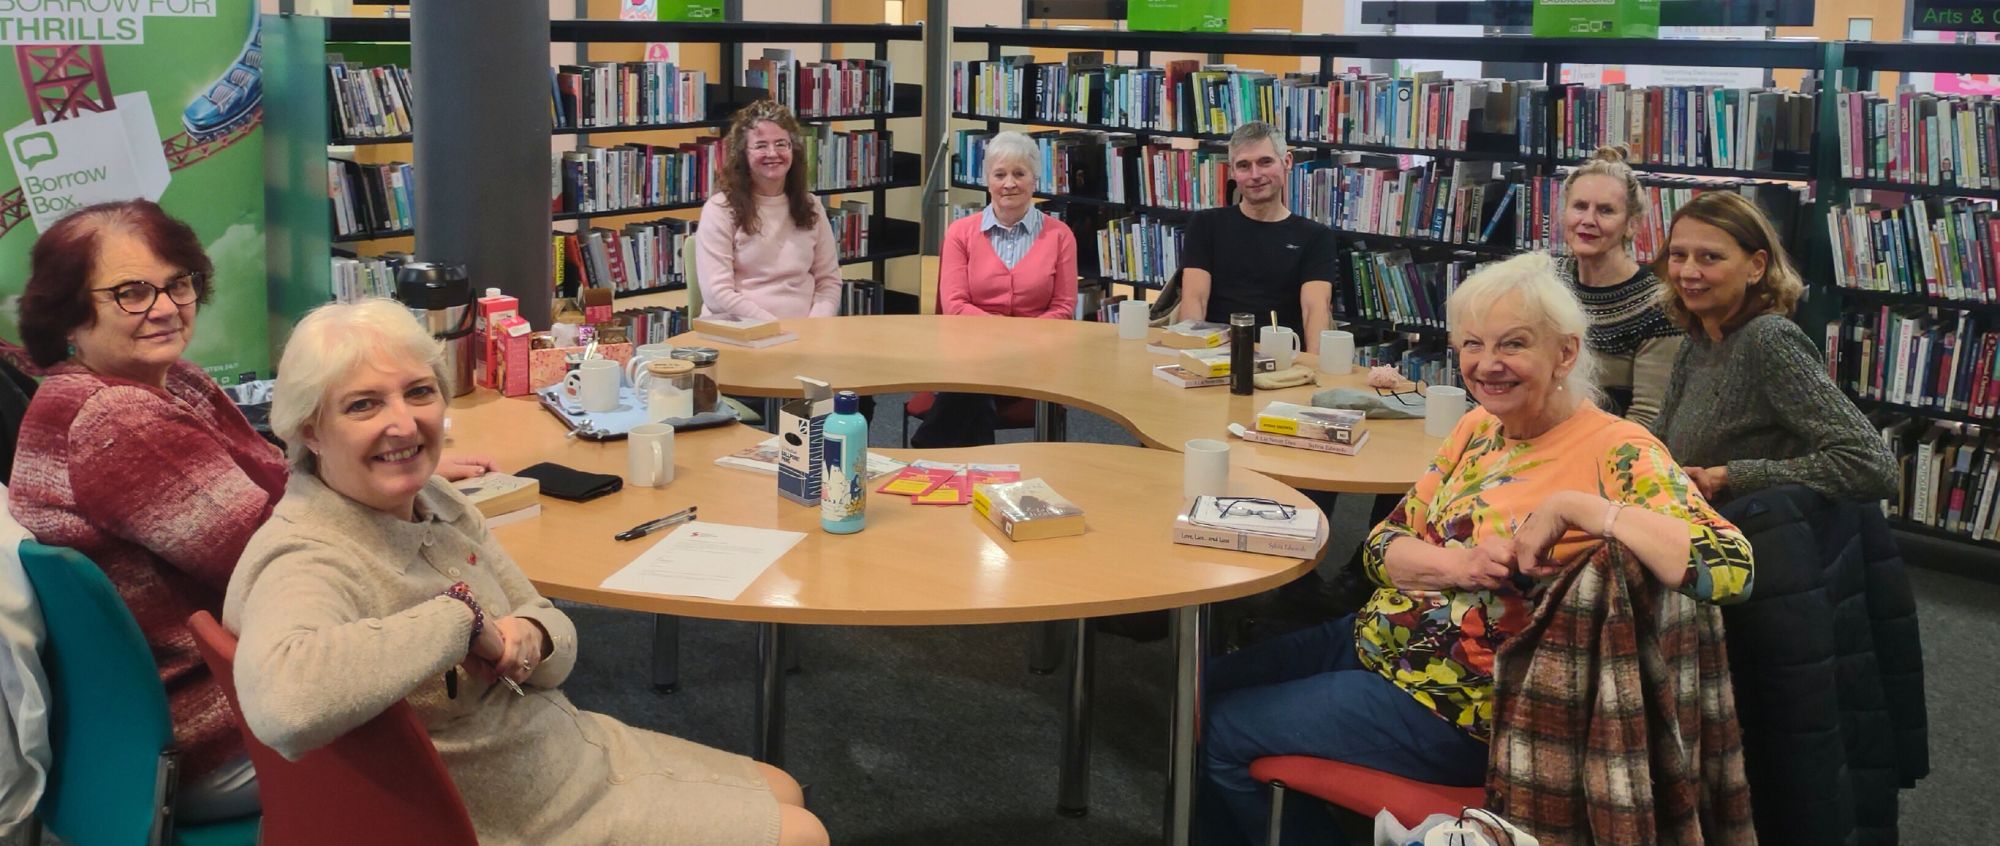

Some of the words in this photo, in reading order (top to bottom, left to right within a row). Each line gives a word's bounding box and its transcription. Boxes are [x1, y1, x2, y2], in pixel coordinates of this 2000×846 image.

[149, 0, 212, 14] FOR
[1922, 7, 1964, 24] Arts
[1970, 7, 1985, 25] &
[0, 17, 137, 41] THRILLS
[25, 165, 107, 195] Borrow
